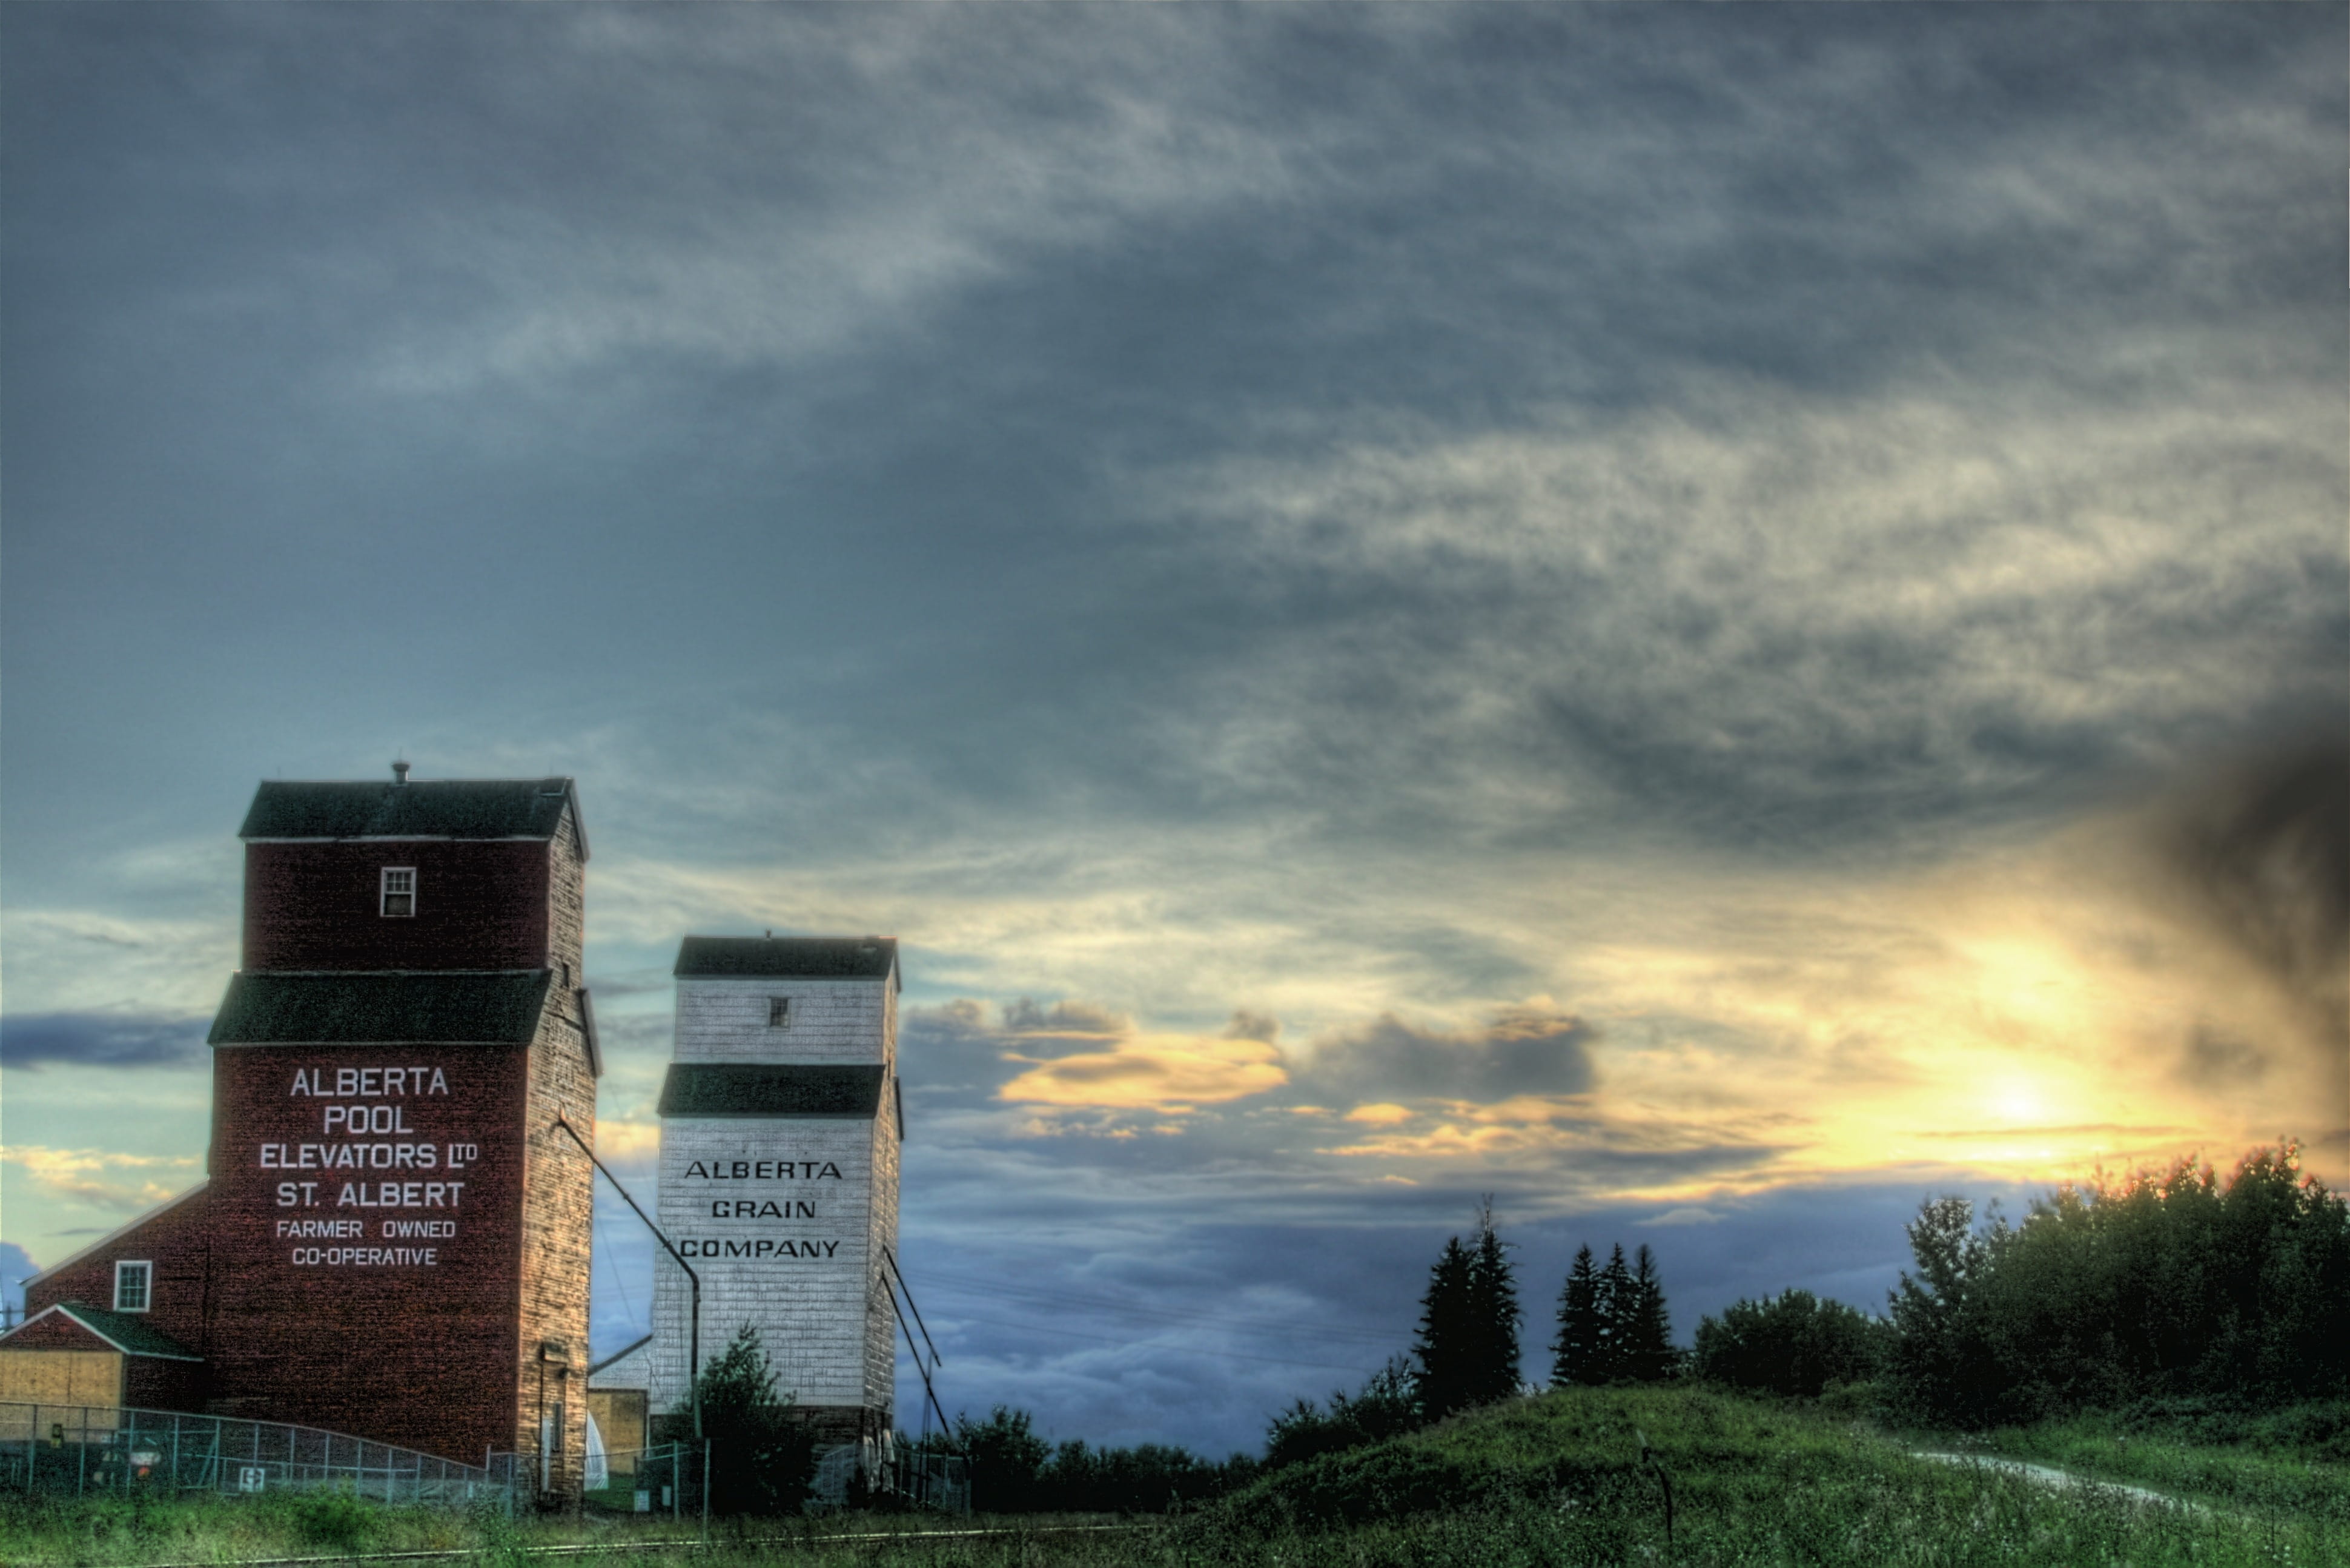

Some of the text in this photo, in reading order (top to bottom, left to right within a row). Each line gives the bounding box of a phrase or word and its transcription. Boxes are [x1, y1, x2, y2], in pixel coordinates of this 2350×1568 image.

[290, 1067, 449, 1096] ALBERTA
[323, 1106, 414, 1134] POOL
[260, 1144, 478, 1168] ELEVATORS LTD
[684, 1161, 842, 1180] ALBERTA
[276, 1182, 465, 1206] ST. ALBERT
[712, 1201, 815, 1219] GRAIN
[277, 1221, 455, 1237] FARMER OWNED
[293, 1248, 437, 1265] CO-OPERATIVE
[680, 1240, 839, 1258] COMPANY
